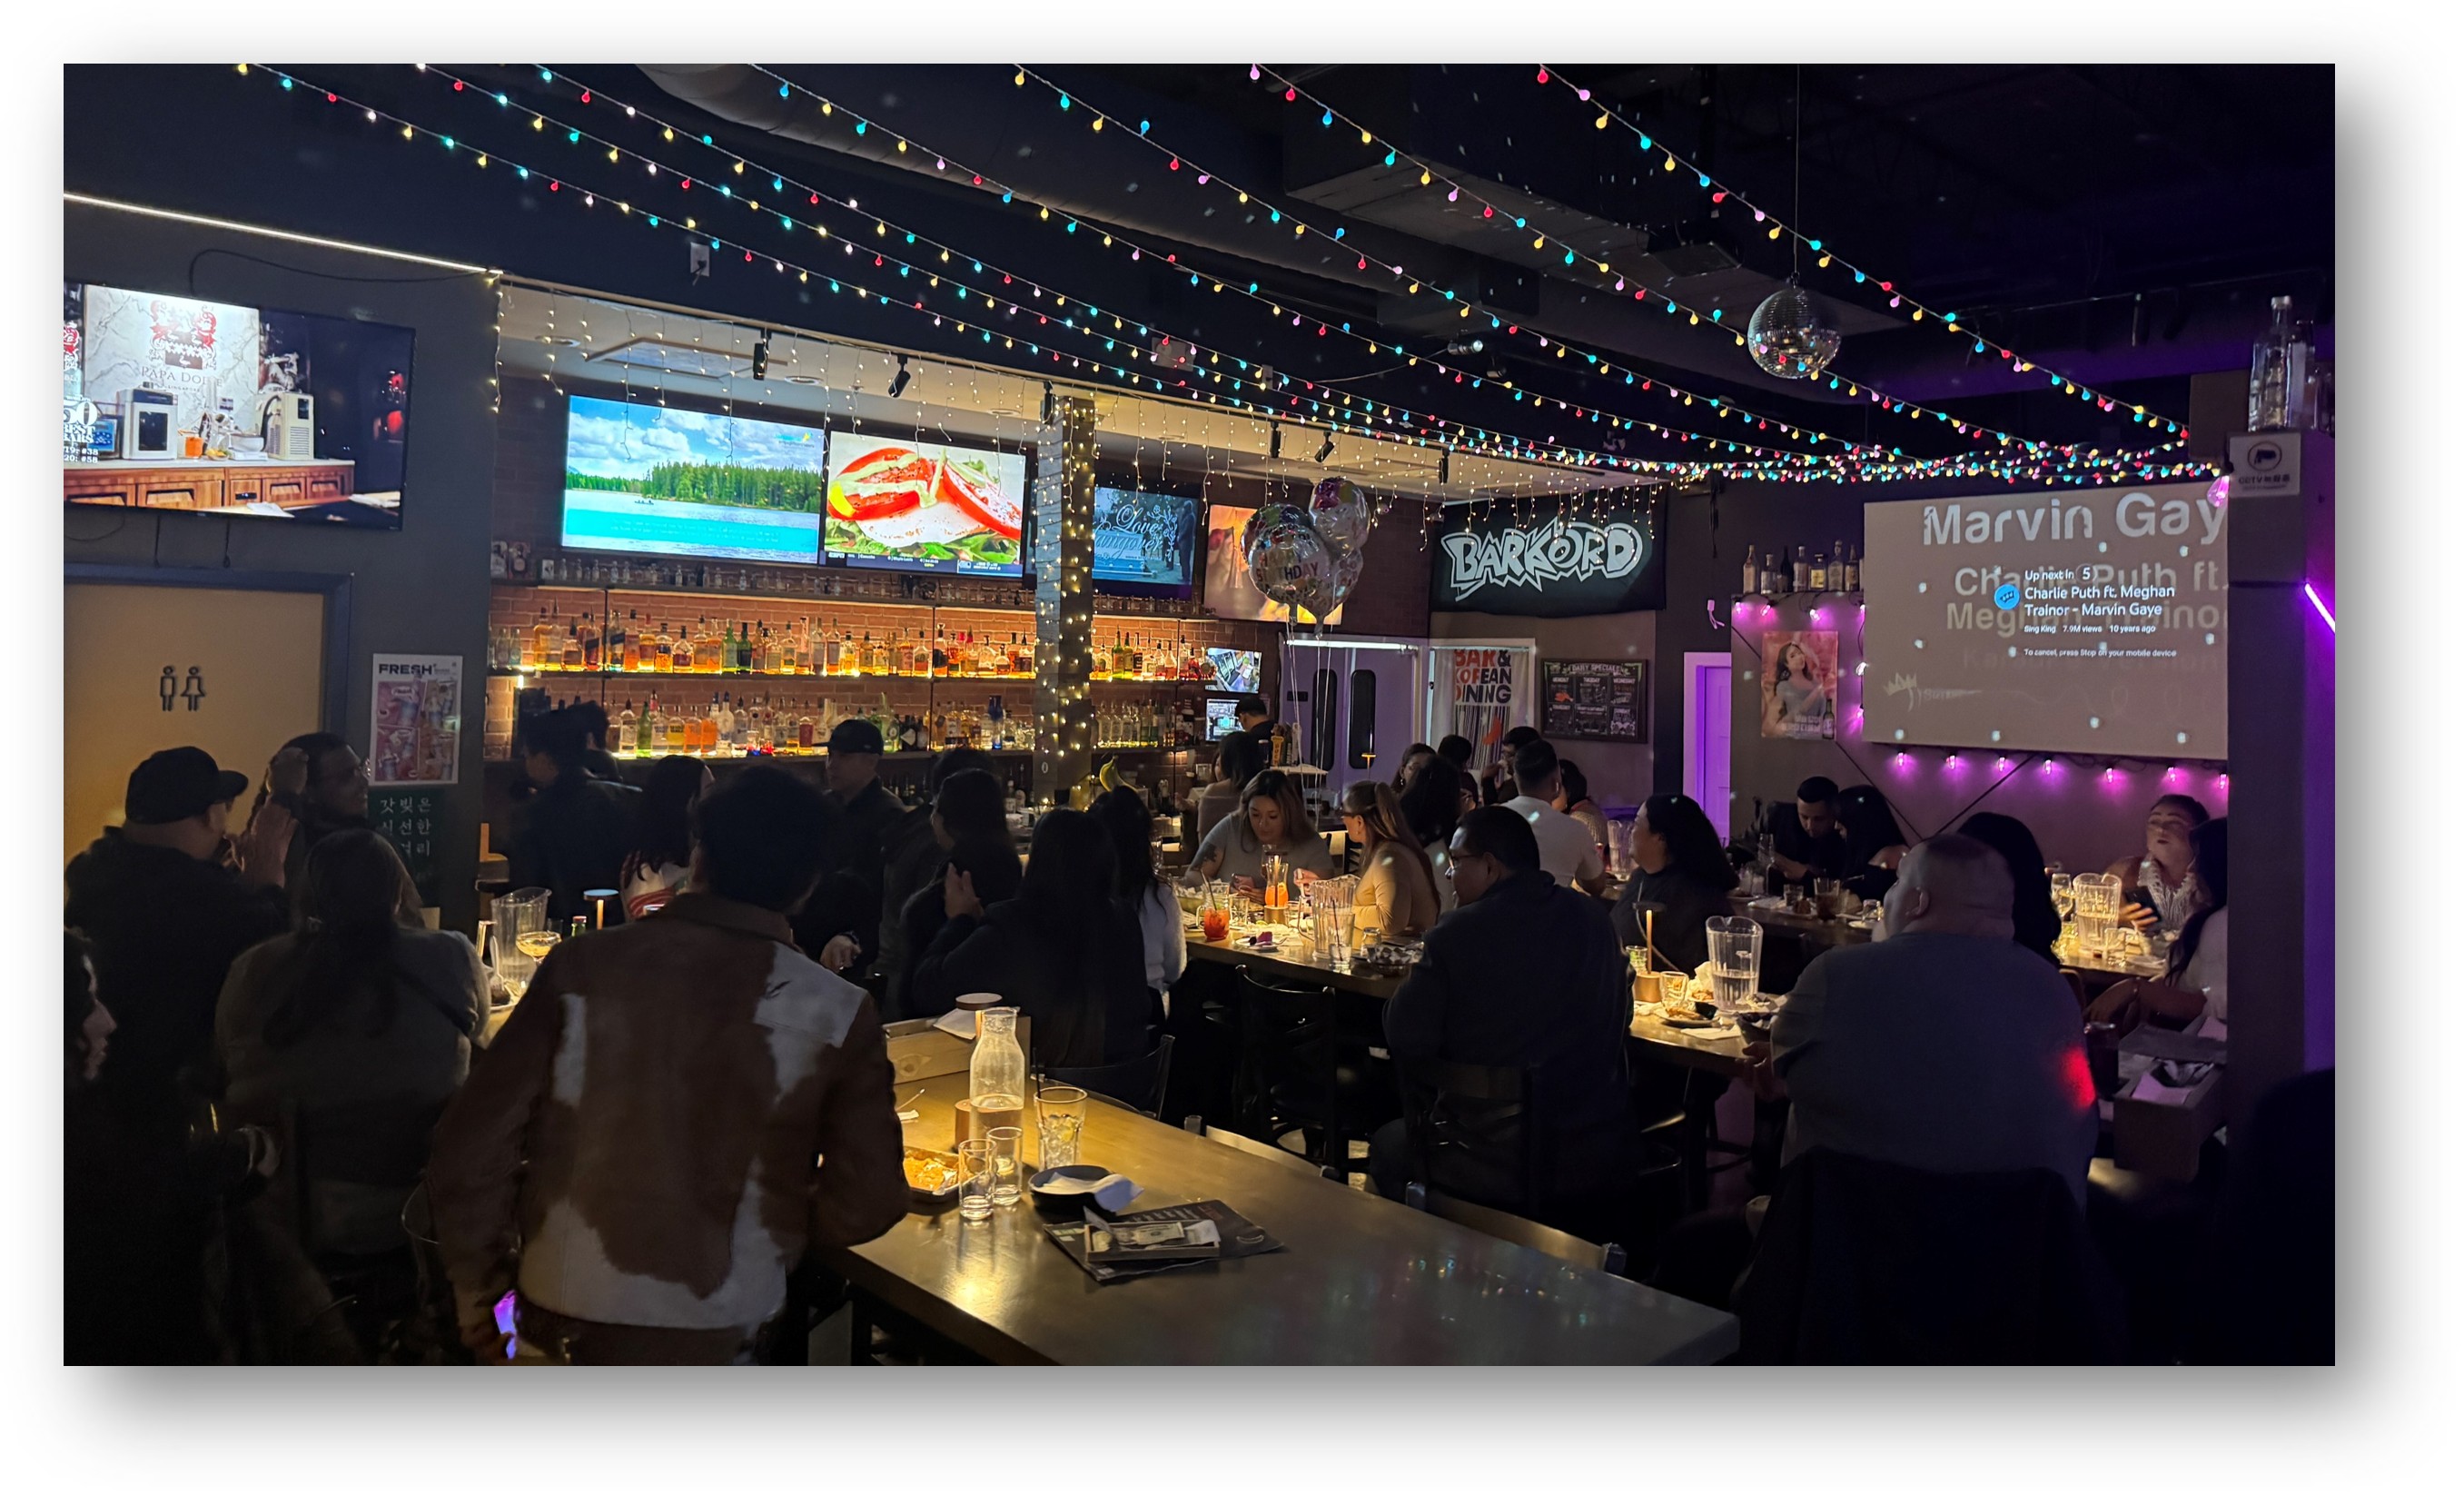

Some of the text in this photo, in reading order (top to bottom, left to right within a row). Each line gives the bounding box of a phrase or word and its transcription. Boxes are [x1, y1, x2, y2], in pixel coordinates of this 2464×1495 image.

[142, 366, 223, 387] PAPA DOE
[1112, 504, 1163, 534] Love
[1923, 498, 2093, 545] Marvin
[1441, 517, 1642, 599] BARKORD
[2024, 567, 2091, 582] Up next in 5
[2024, 584, 2175, 600] Charlie Puth ft. Meghan
[2024, 604, 2070, 617] Trainor
[2082, 602, 2126, 617] Marvin
[2129, 602, 2162, 618] Gaye
[2024, 625, 2040, 634] Sing
[2040, 625, 2056, 634] King
[2082, 625, 2103, 633] views
[2109, 624, 2119, 633] 10
[2120, 625, 2140, 634] years
[2142, 626, 2156, 634] ago
[1498, 649, 1511, 668] &
[2024, 648, 2034, 657] To
[2080, 648, 2096, 658] Stop
[2125, 648, 2152, 657] mobile
[2152, 648, 2177, 657] device
